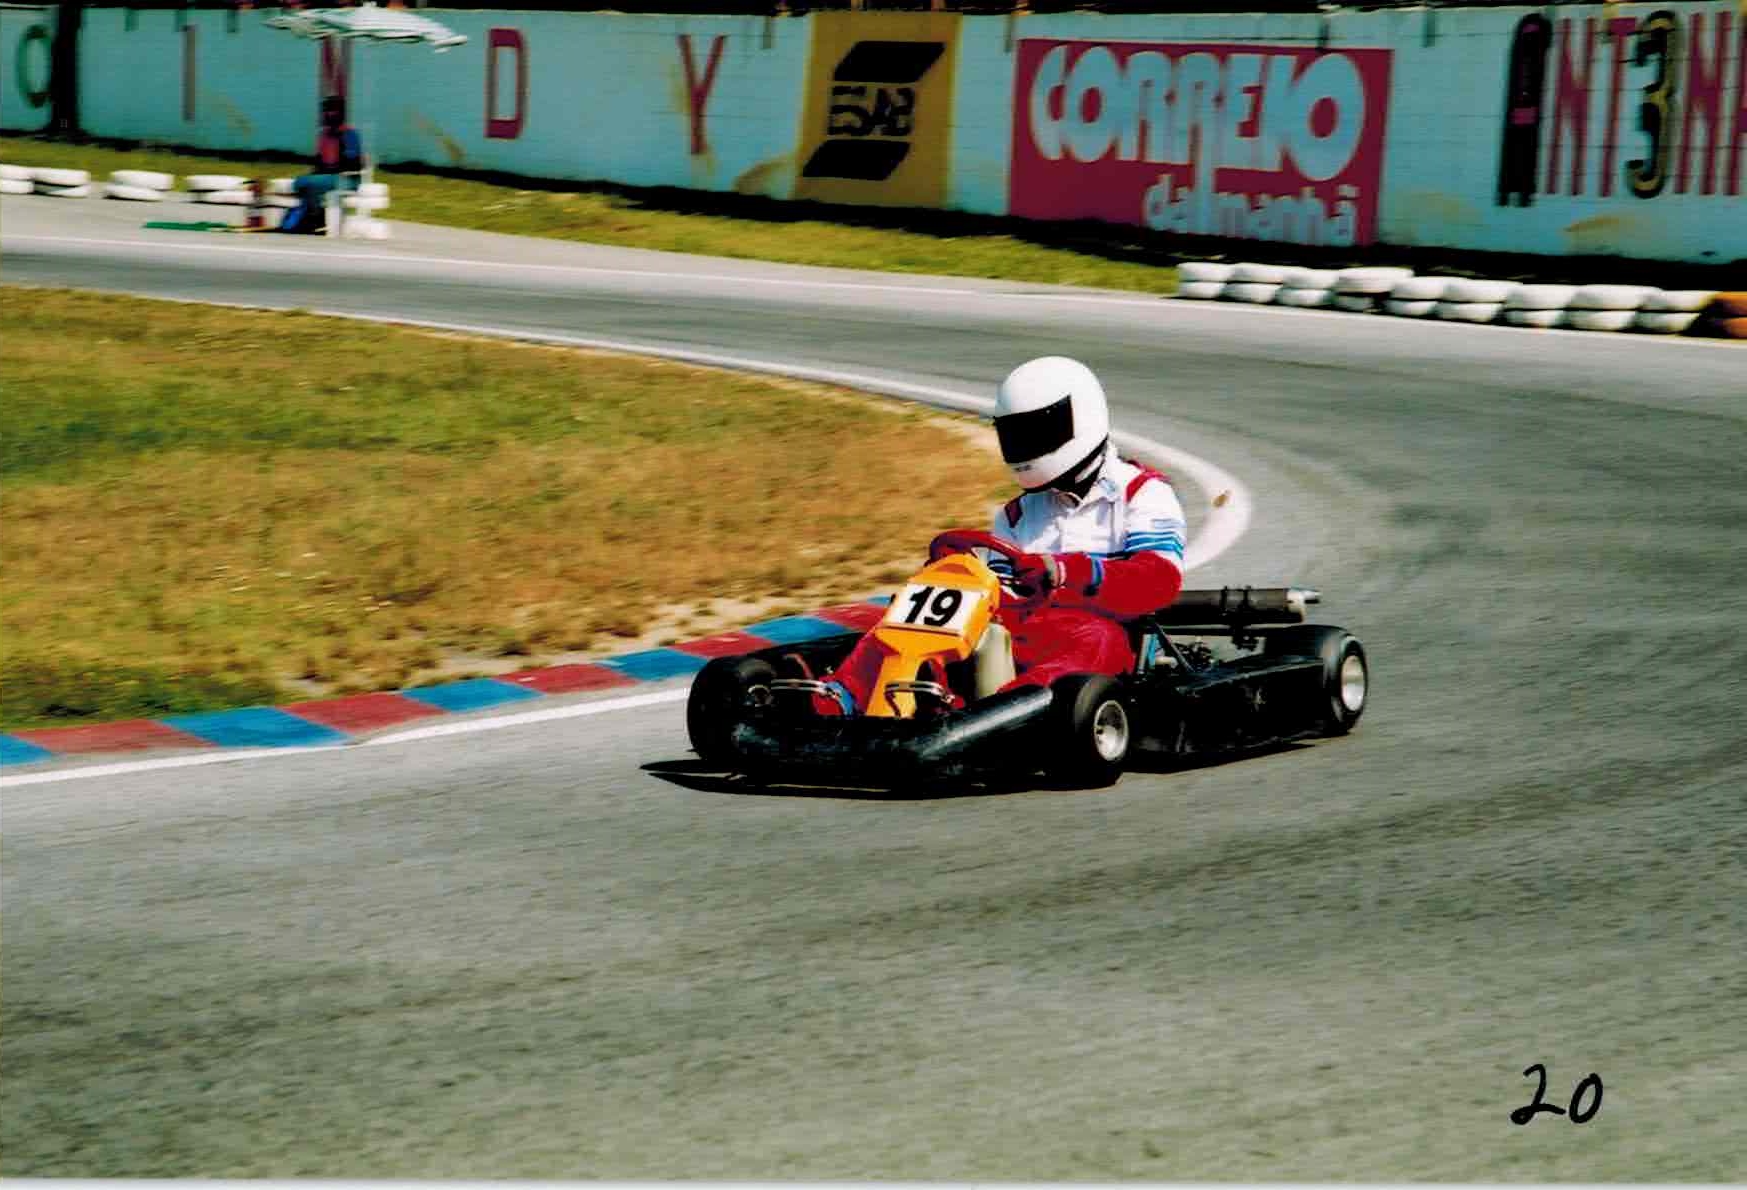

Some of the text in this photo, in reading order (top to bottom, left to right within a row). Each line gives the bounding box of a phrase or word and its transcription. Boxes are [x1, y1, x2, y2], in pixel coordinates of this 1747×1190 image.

[1029, 45, 1366, 182] CORREIO
[1214, 184, 1358, 247] manhã
[904, 586, 963, 627] 19
